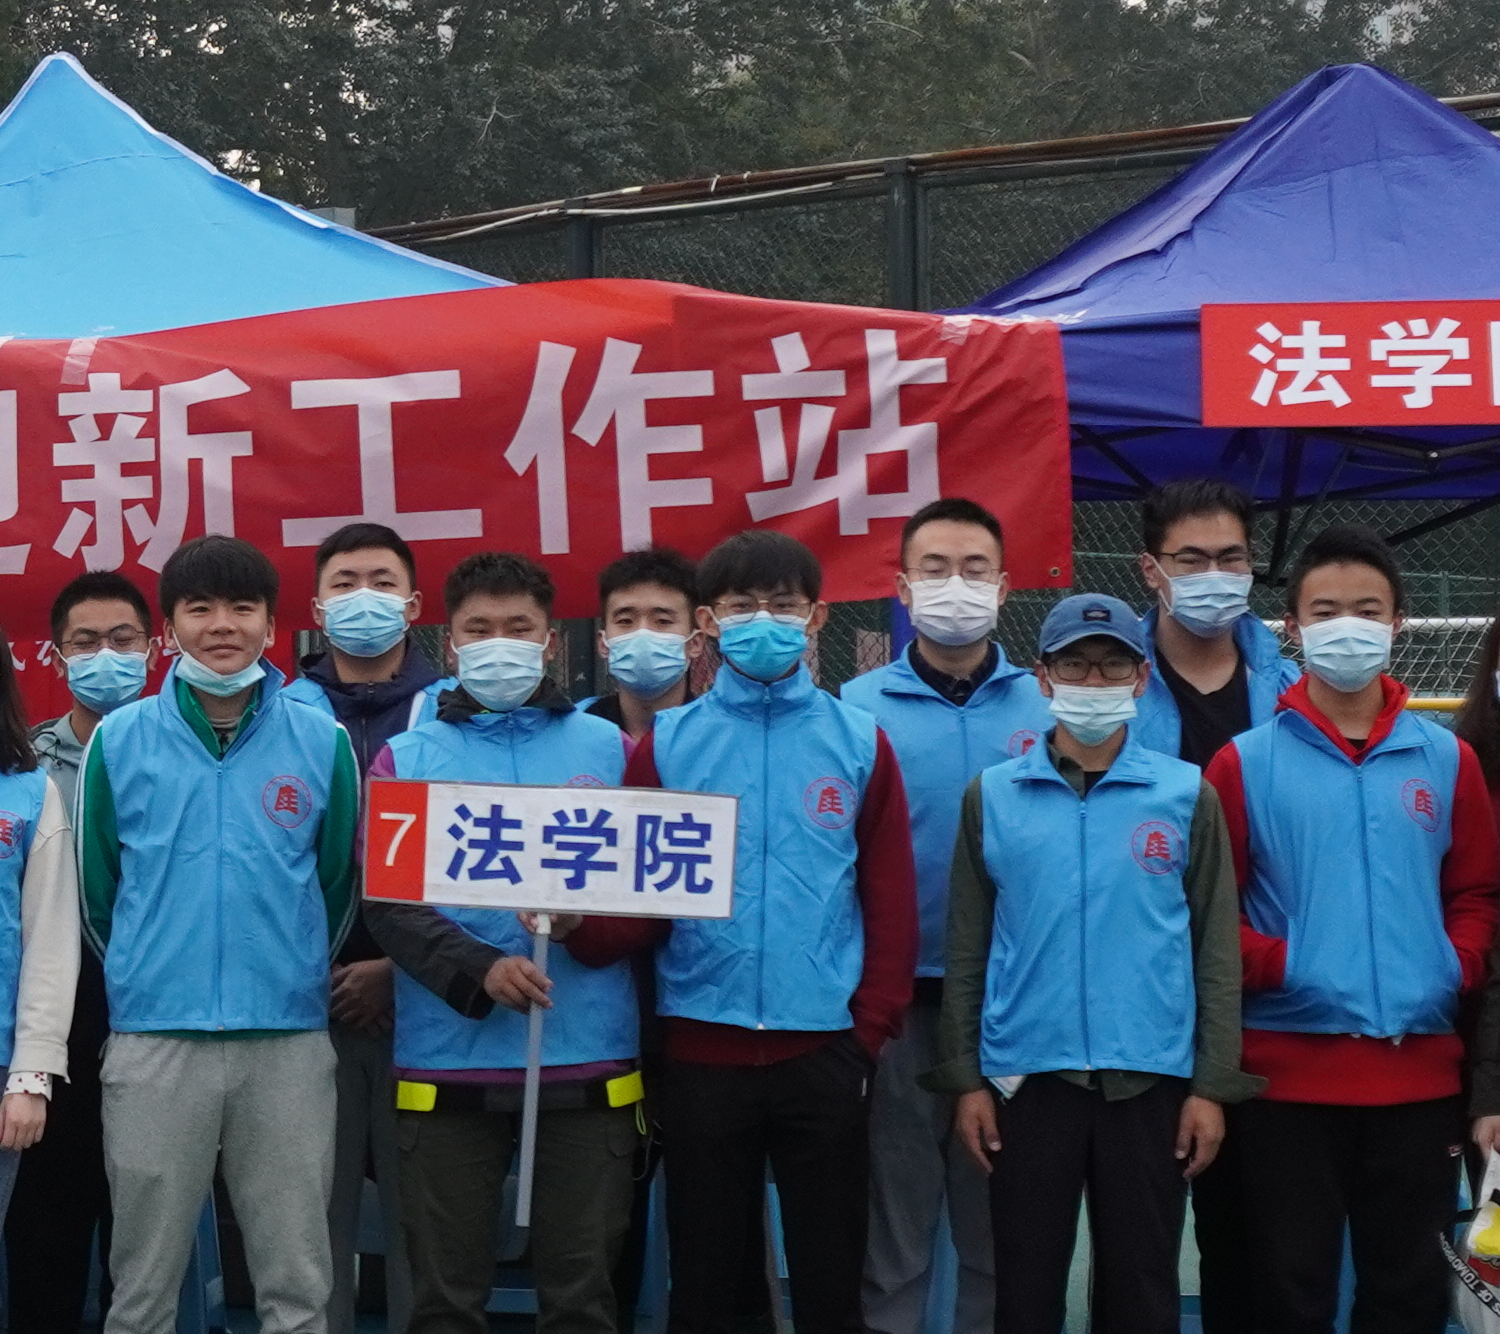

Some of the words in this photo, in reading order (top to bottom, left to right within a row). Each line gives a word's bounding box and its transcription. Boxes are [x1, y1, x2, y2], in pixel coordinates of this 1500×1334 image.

[379, 812, 417, 867] 7
[445, 803, 714, 895] 法学院
